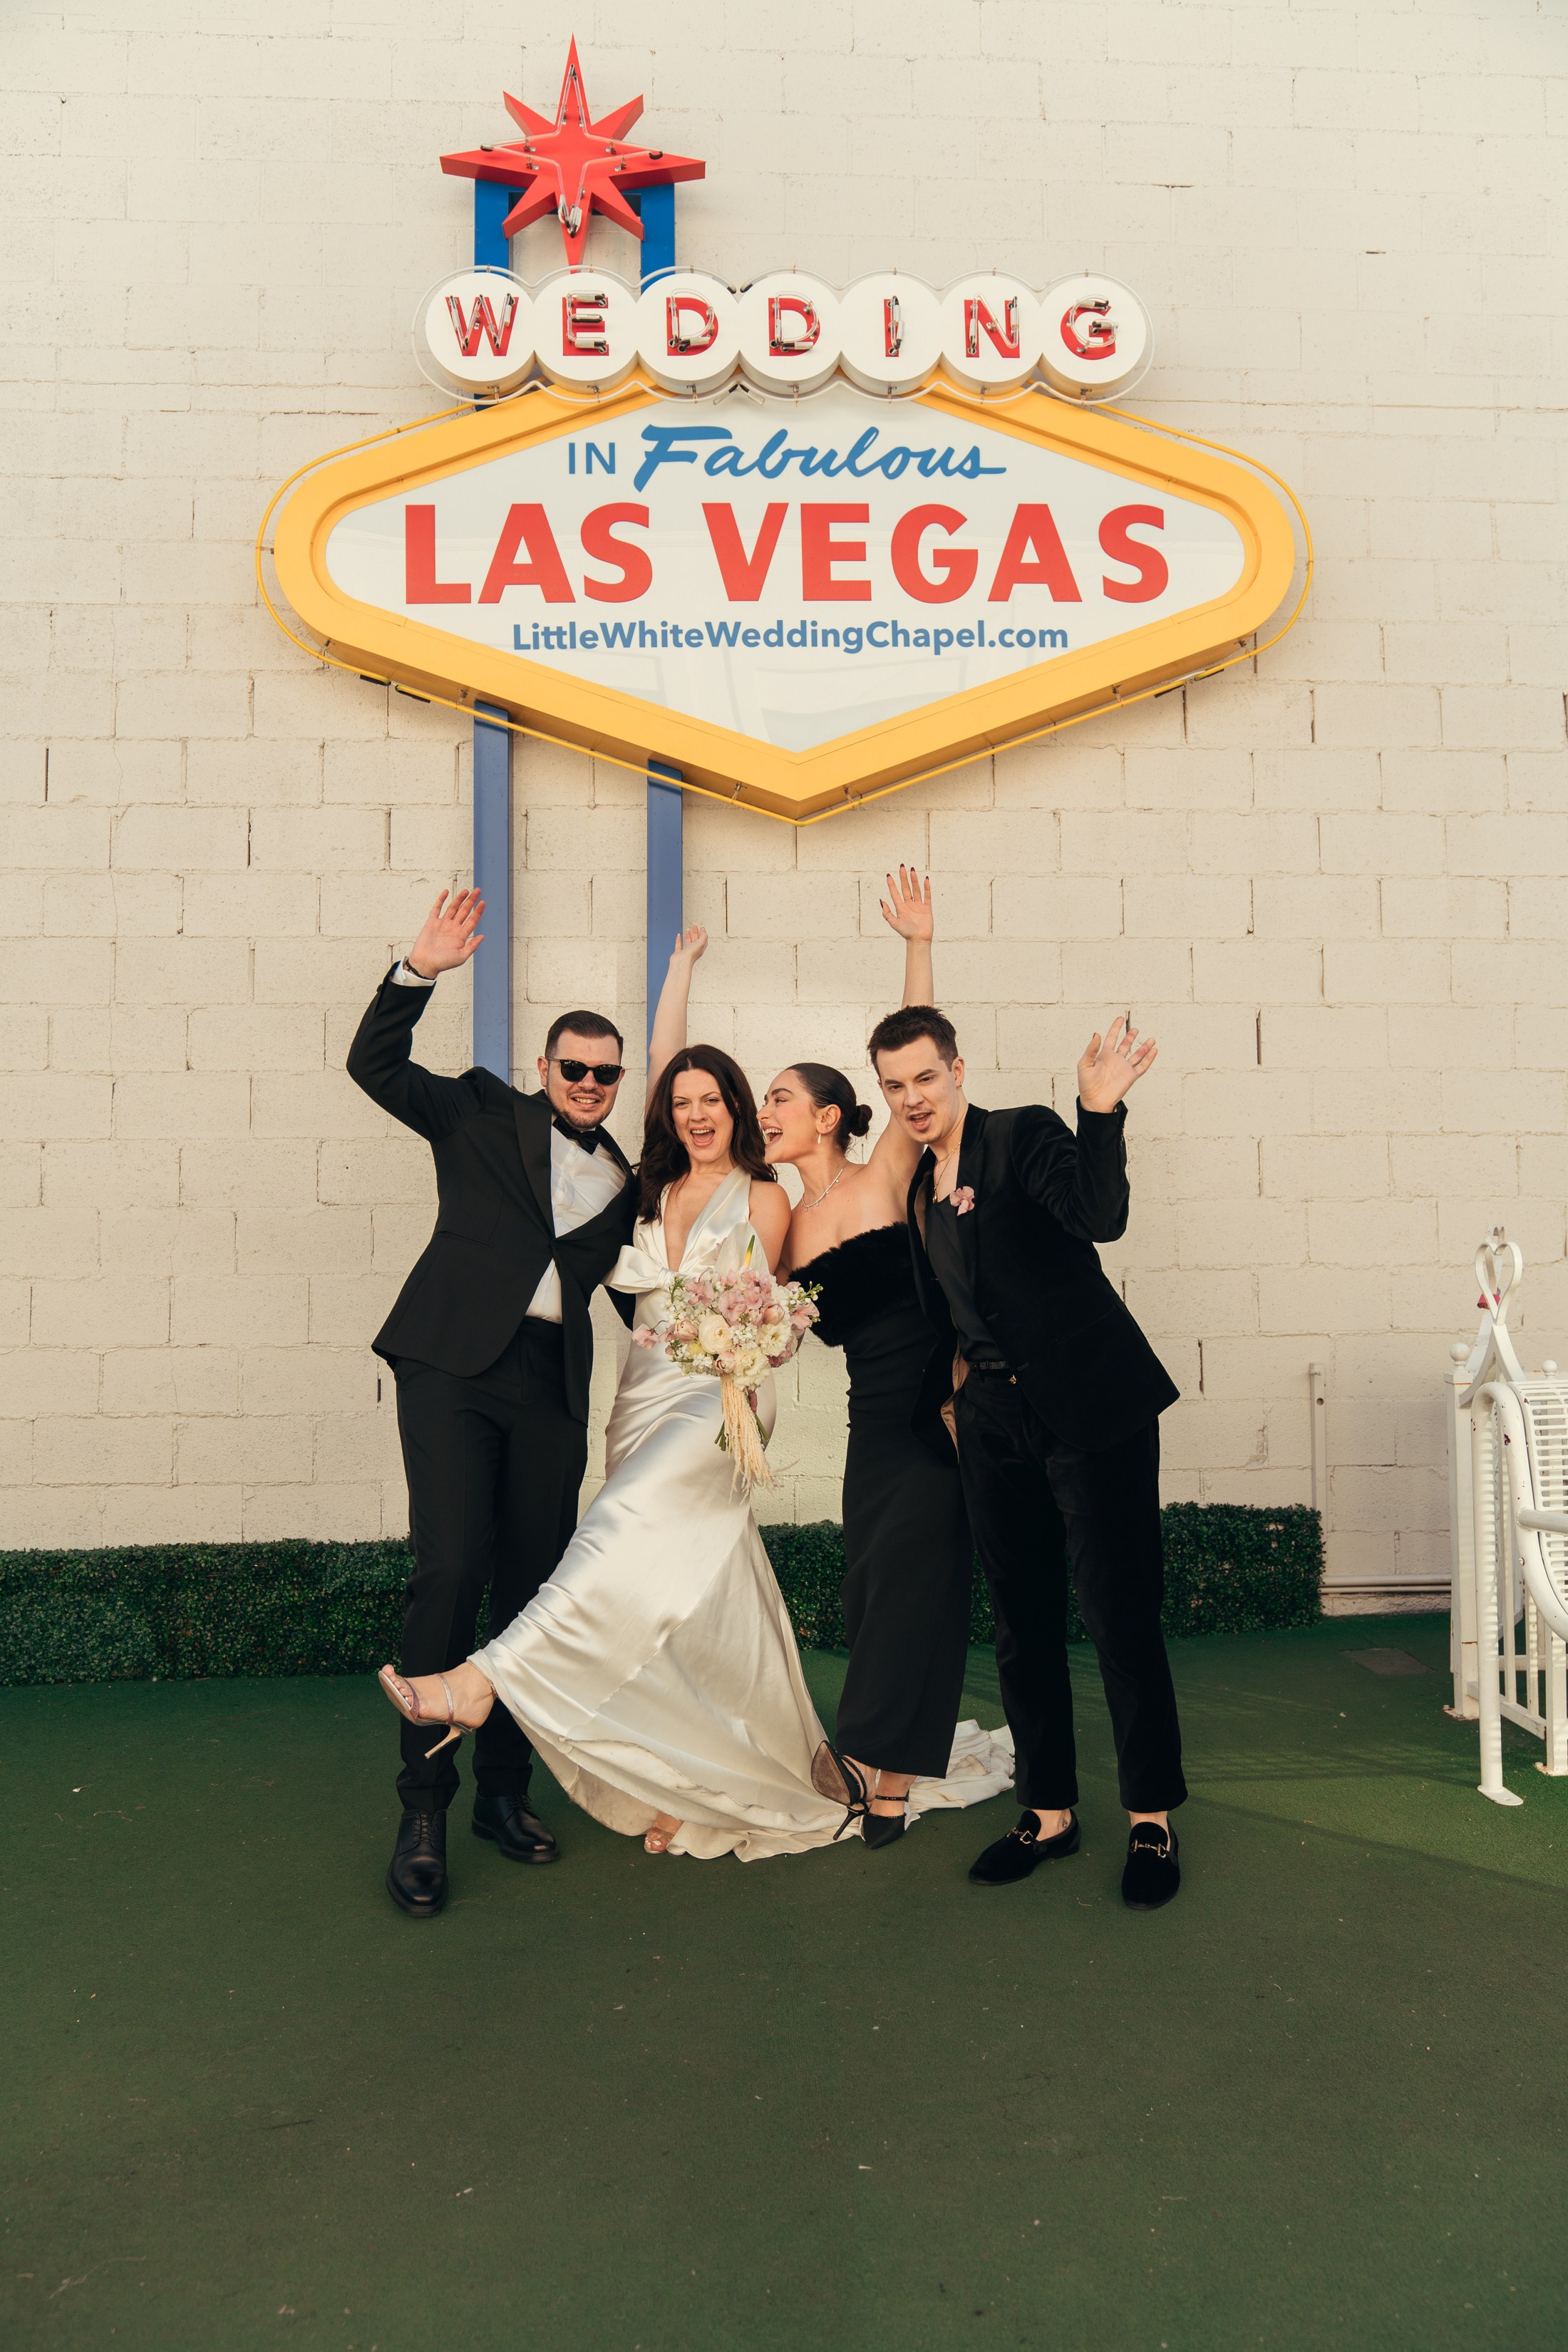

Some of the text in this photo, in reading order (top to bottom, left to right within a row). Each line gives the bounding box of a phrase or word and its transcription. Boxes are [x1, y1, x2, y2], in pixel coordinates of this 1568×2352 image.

[445, 291, 1119, 360] WEDDING
[569, 424, 1007, 492] IN Fabulous
[405, 502, 1170, 604] LAS VEGAS
[512, 619, 1069, 656] LittleWhiteWeddingChapel.com
